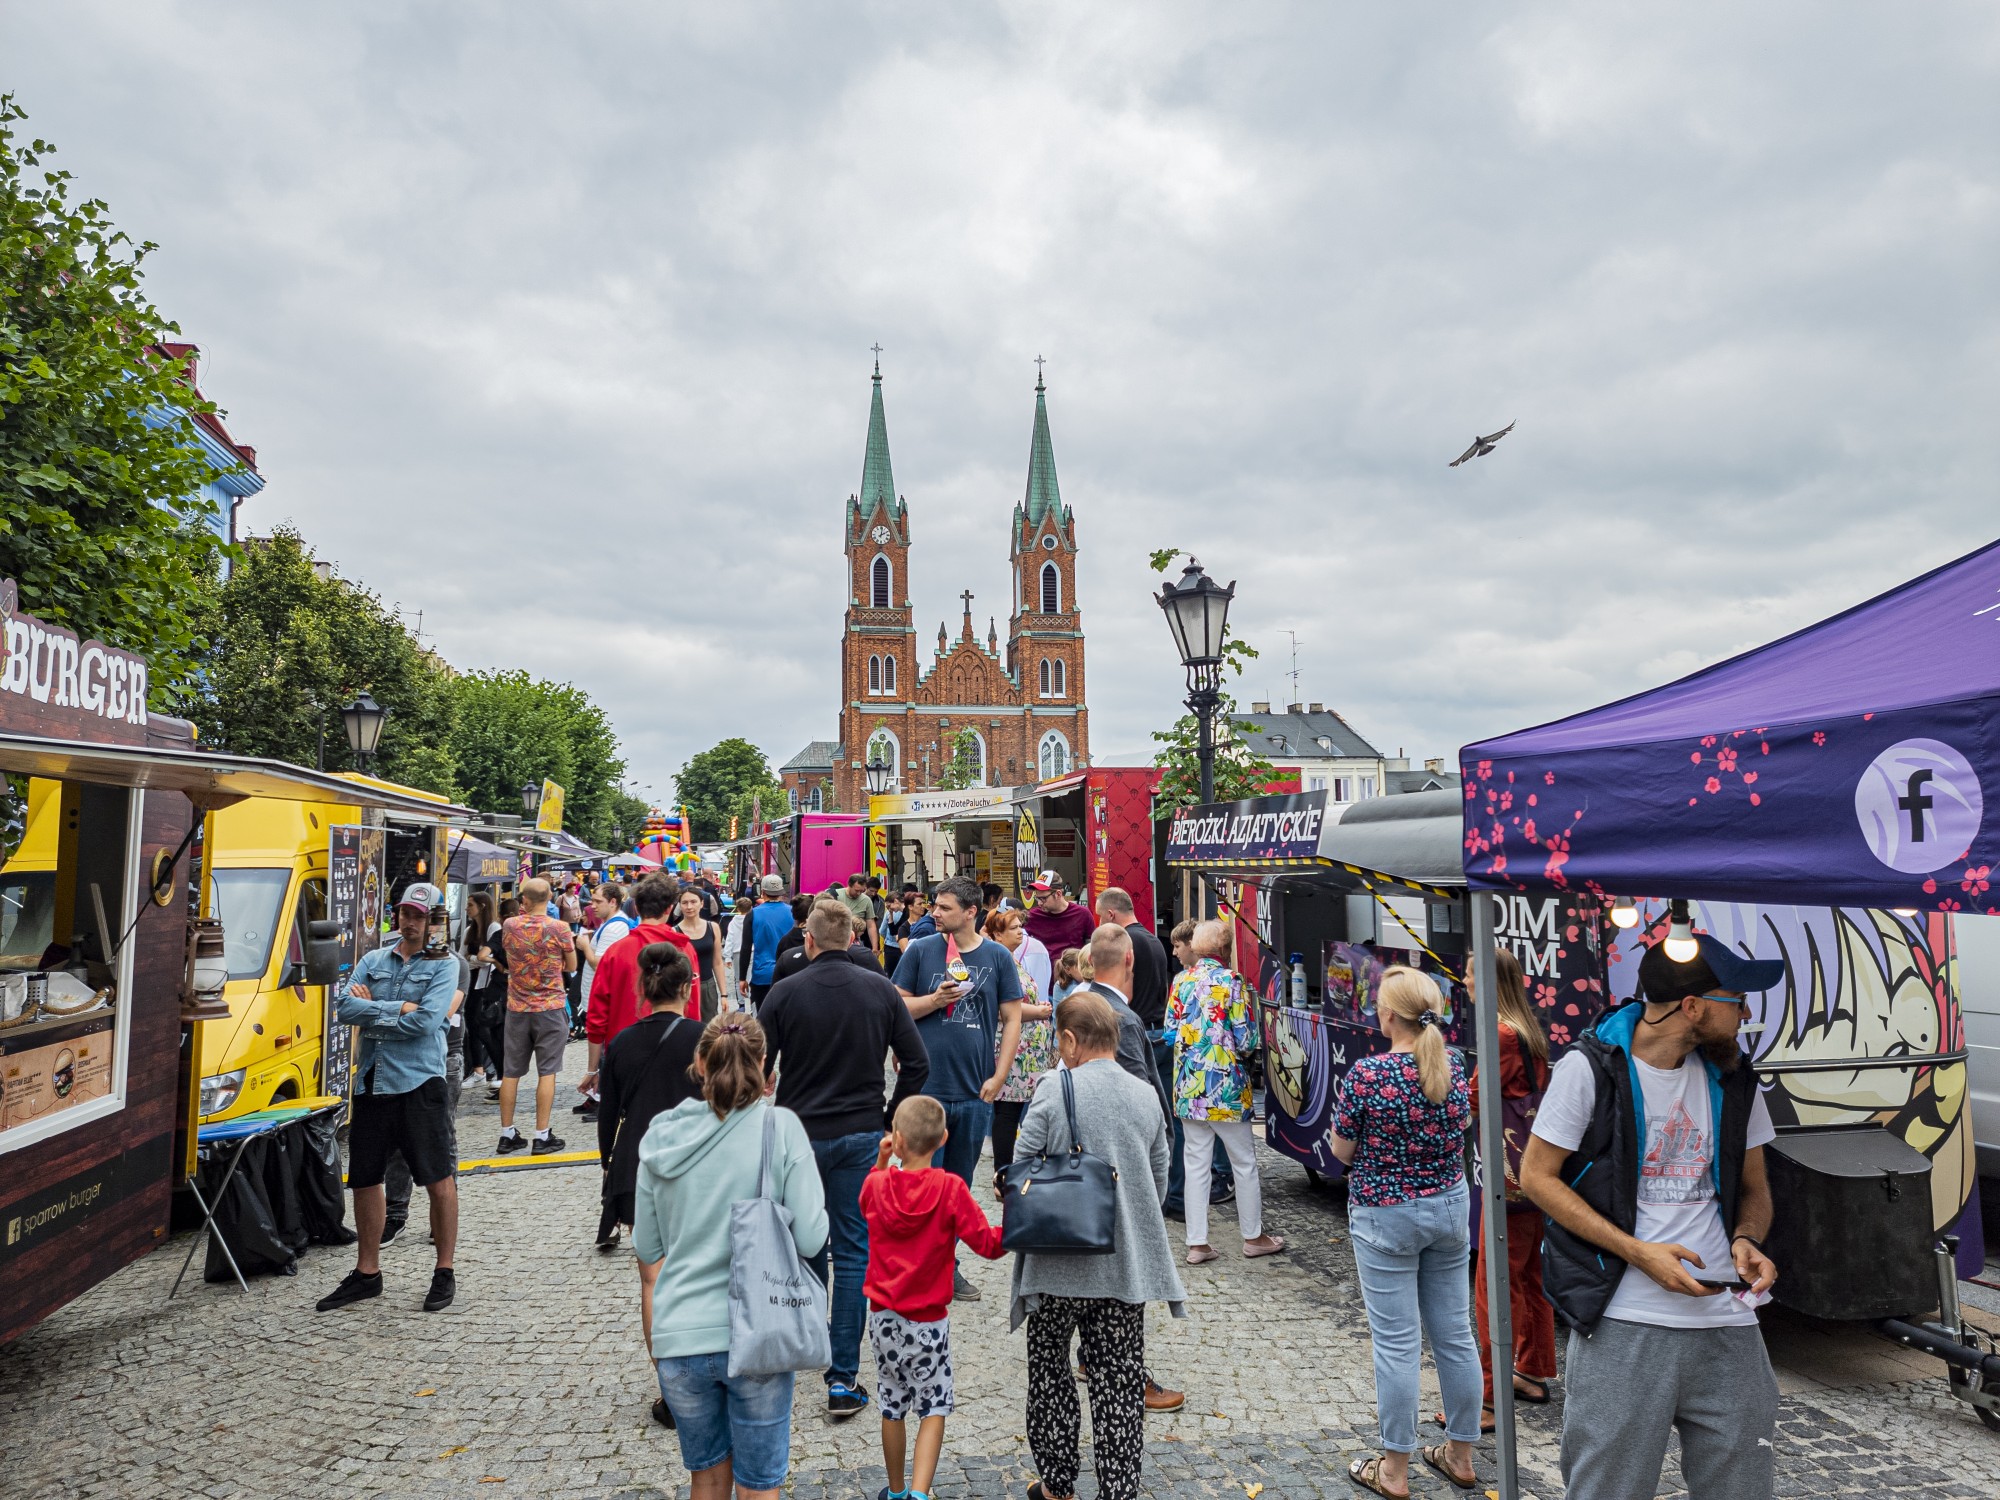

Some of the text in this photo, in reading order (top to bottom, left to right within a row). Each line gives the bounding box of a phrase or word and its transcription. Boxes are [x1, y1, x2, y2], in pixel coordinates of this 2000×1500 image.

[0, 618, 147, 725] BURGER
[1227, 804, 1321, 850] AZJATYCKIE
[1016, 842, 1040, 868] FRYTKA
[24, 1199, 68, 1236] sparrow
[69, 1182, 102, 1209] burger
[769, 1295, 779, 1306] NA
